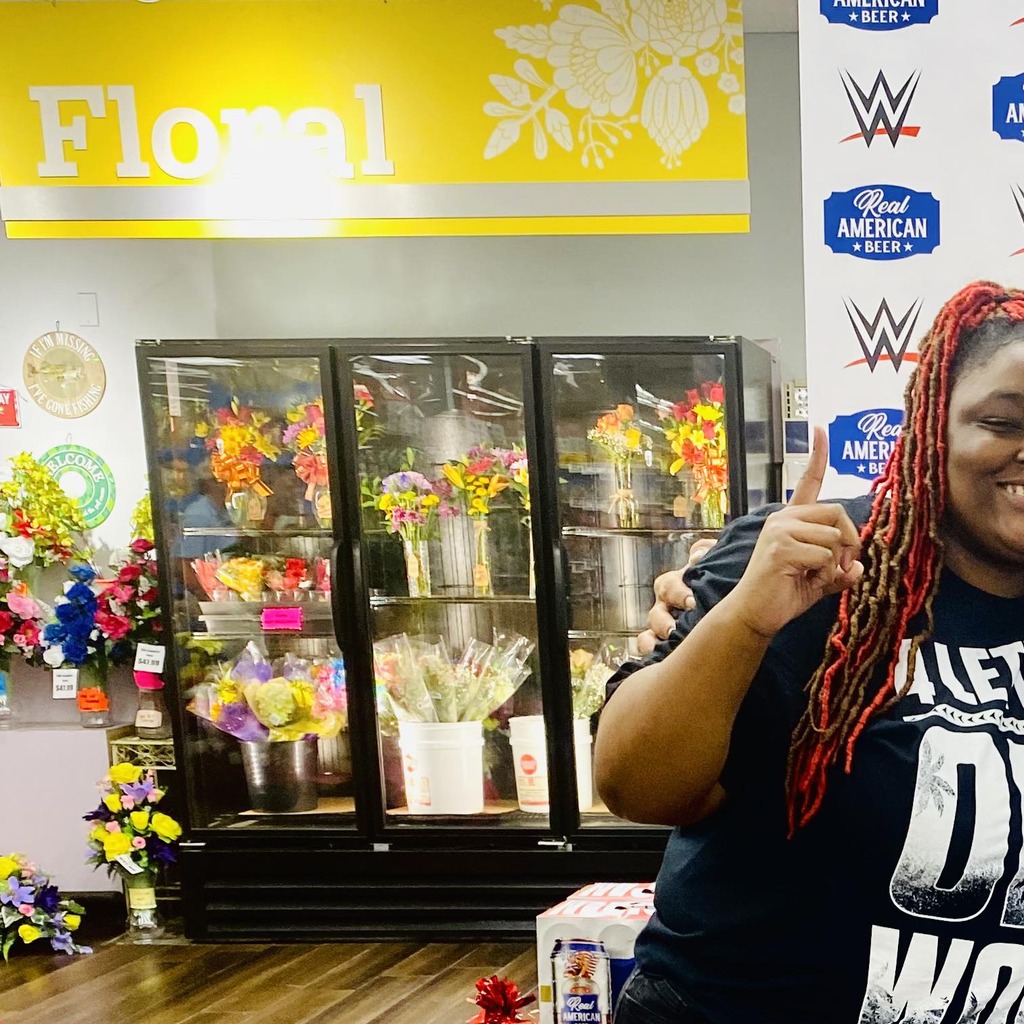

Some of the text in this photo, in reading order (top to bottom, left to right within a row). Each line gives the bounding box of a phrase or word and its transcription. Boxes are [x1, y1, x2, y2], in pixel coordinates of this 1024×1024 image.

[862, 10, 898, 23] BEER
[29, 83, 395, 180] Floral
[853, 188, 909, 217] Real
[837, 217, 928, 239] AMERICAN
[864, 241, 901, 253] BEER
[29, 343, 41, 360] IF
[55, 332, 95, 362] MISSING
[46, 398, 72, 415] GONE
[72, 384, 101, 416] FISHING
[857, 412, 902, 441] Rea
[48, 452, 105, 483] ELCOME
[562, 1012, 601, 1022] AMERICAN
[566, 996, 595, 1011] Real
